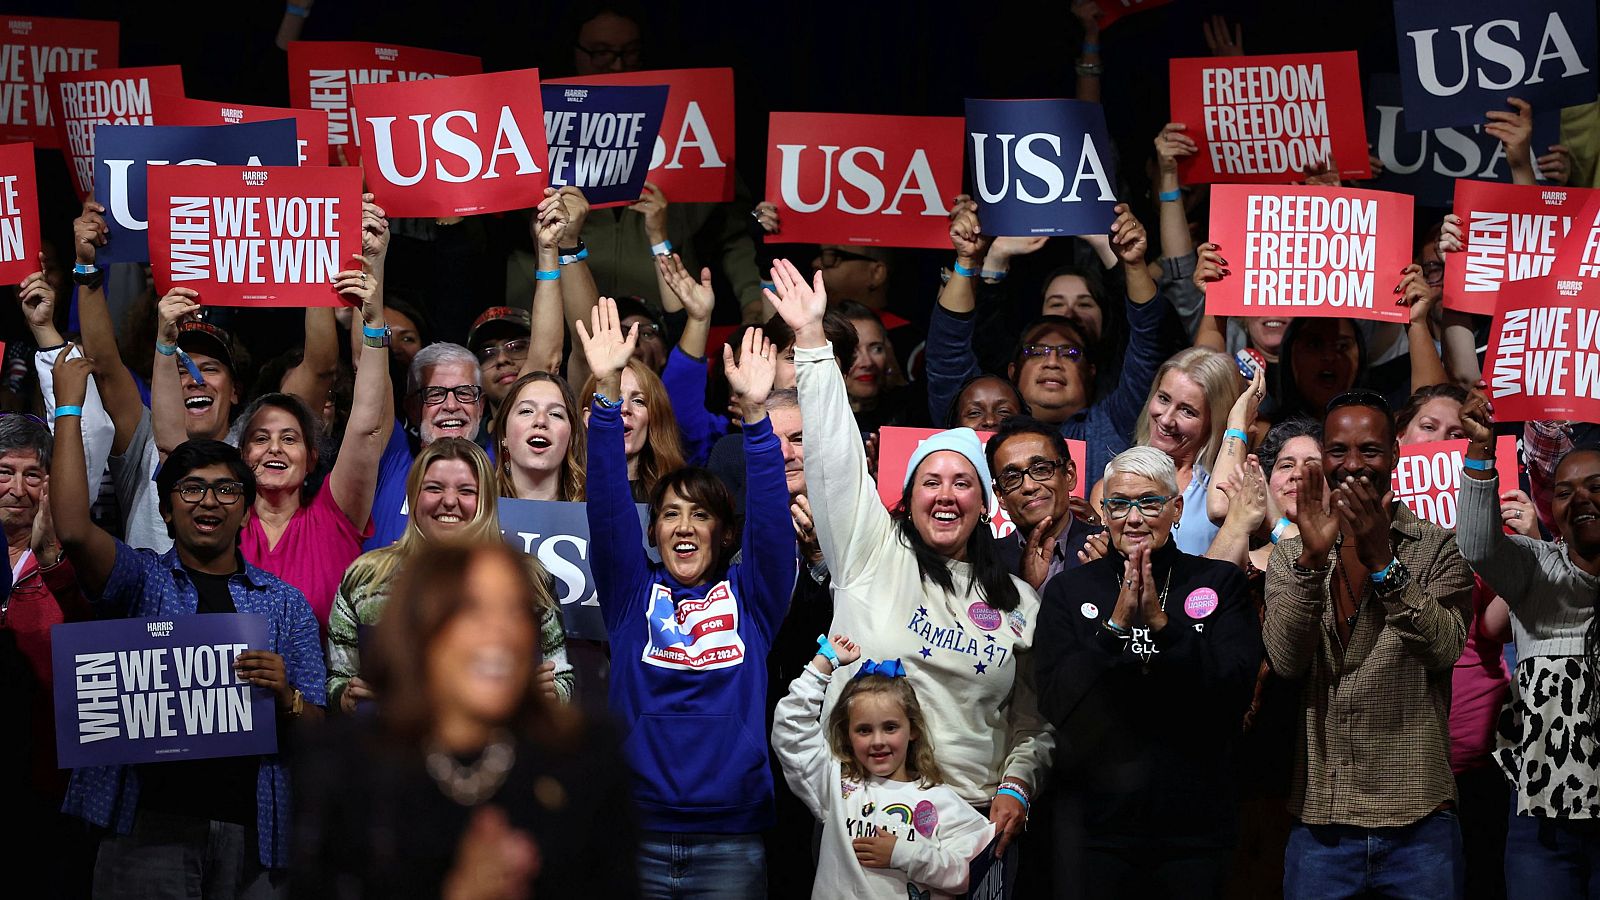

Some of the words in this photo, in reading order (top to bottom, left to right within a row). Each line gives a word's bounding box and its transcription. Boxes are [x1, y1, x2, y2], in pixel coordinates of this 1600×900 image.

[1406, 12, 1590, 97] USA
[60, 78, 152, 119] FREEDOM
[564, 89, 589, 98] HARRIS
[1202, 63, 1326, 106] FREEDOM
[221, 107, 244, 119] HARRIS
[579, 112, 646, 149] VOTE
[1203, 100, 1330, 142] FREEDOM
[365, 105, 541, 186] USA
[1208, 136, 1332, 175] FREEDOM
[242, 170, 269, 181] HARRIS
[575, 147, 637, 187] WIN
[776, 144, 951, 217] USA
[970, 132, 1117, 204] USA
[1246, 194, 1378, 236] FREEDOM
[1541, 190, 1568, 201] HARRIS
[212, 197, 261, 238] WE
[266, 196, 341, 238] VOTE
[1511, 213, 1558, 254] WE
[170, 196, 211, 282] WHEN
[1244, 231, 1376, 271] FREEDOM
[1464, 210, 1509, 292] WHEN
[212, 239, 266, 284] WE
[269, 239, 341, 285] WIN
[1243, 268, 1375, 309] FREEDOM
[1556, 280, 1584, 291] HARRIS
[1559, 289, 1578, 297] WALZ
[1529, 307, 1572, 349] WE
[1491, 308, 1531, 399] WHEN
[1525, 350, 1572, 397] WE
[147, 621, 174, 632] HARRIS
[701, 619, 724, 632] FOR
[907, 612, 978, 657] KAMALA
[983, 643, 1008, 668] 47
[118, 648, 170, 692] WE
[716, 647, 739, 660] 2024
[75, 651, 121, 744] WHEN
[121, 690, 178, 740] WE
[179, 685, 253, 736] WIN
[846, 817, 916, 842] KAMA
